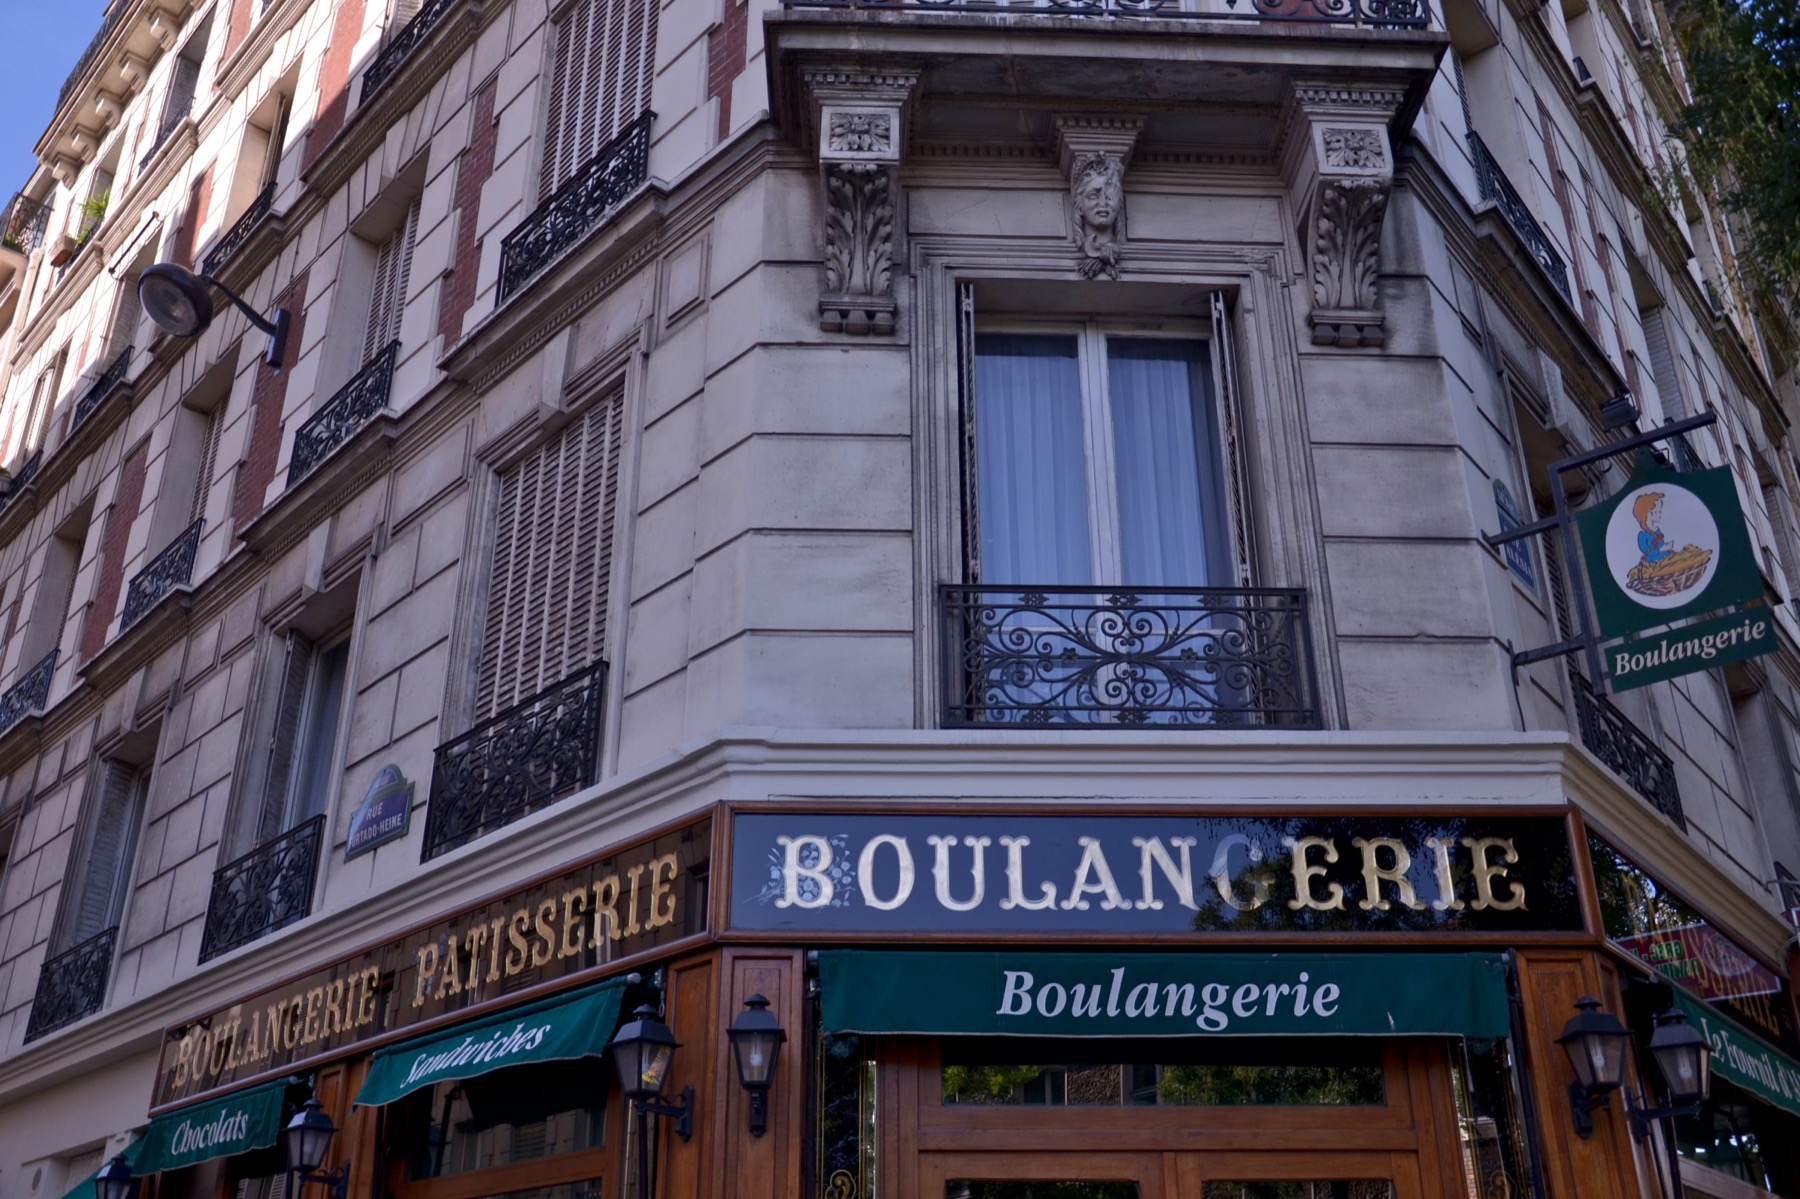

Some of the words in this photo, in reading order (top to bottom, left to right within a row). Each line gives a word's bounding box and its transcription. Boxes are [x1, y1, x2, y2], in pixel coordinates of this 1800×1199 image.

[1613, 618, 1767, 676] Boulangerie
[348, 812, 403, 850] FURTADO-HEINE
[366, 801, 384, 821] RUE
[775, 832, 1529, 913] BOULANGERIE
[171, 964, 380, 1090] BOULANGERIE
[411, 850, 679, 1009] PATISSERIE
[995, 965, 1341, 1033] Boulangerie
[399, 1021, 553, 1090] Sandwiches
[1720, 1030, 1780, 1093] Fournil
[170, 1107, 249, 1157] Chocolats
